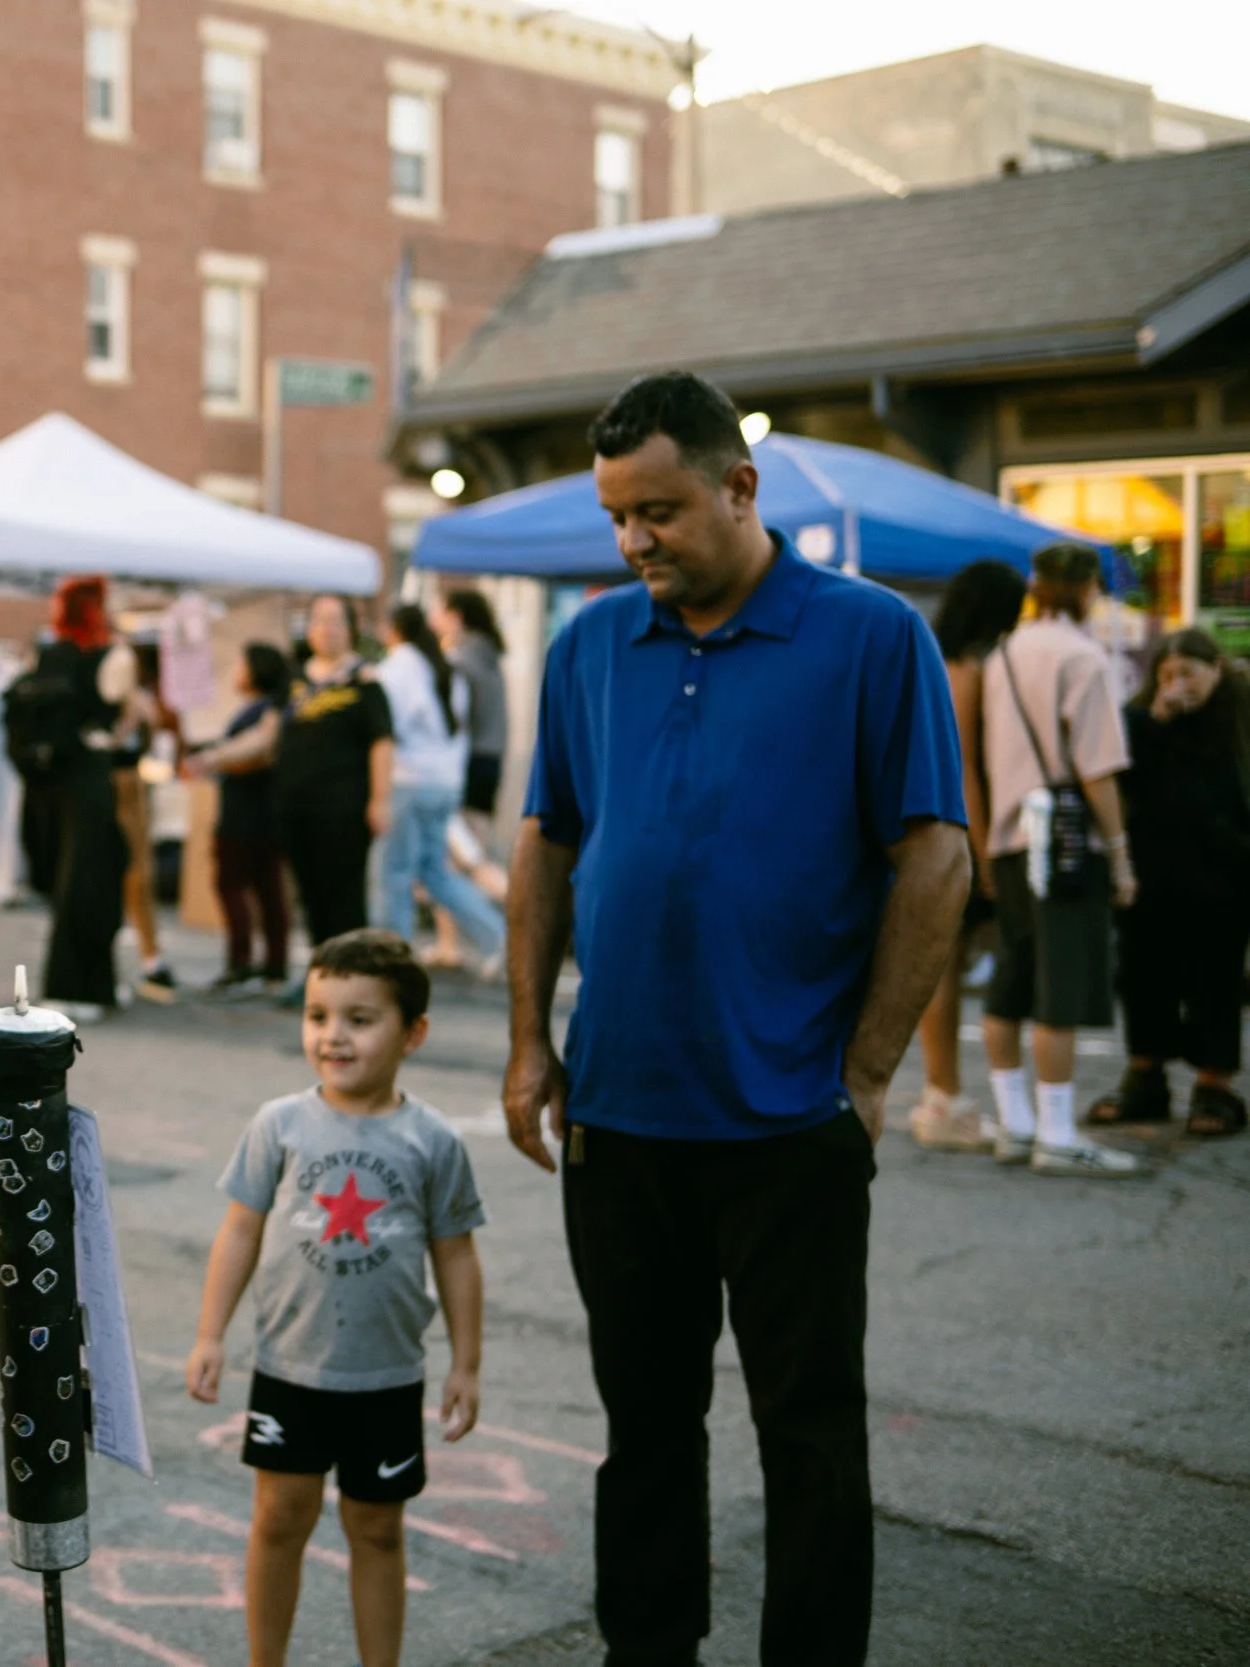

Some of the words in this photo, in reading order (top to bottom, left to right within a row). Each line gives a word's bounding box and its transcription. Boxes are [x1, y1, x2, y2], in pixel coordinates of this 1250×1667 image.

[297, 1150, 405, 1198] CONVERSE
[297, 1239, 327, 1272] ALL
[335, 1245, 392, 1278] STAR
